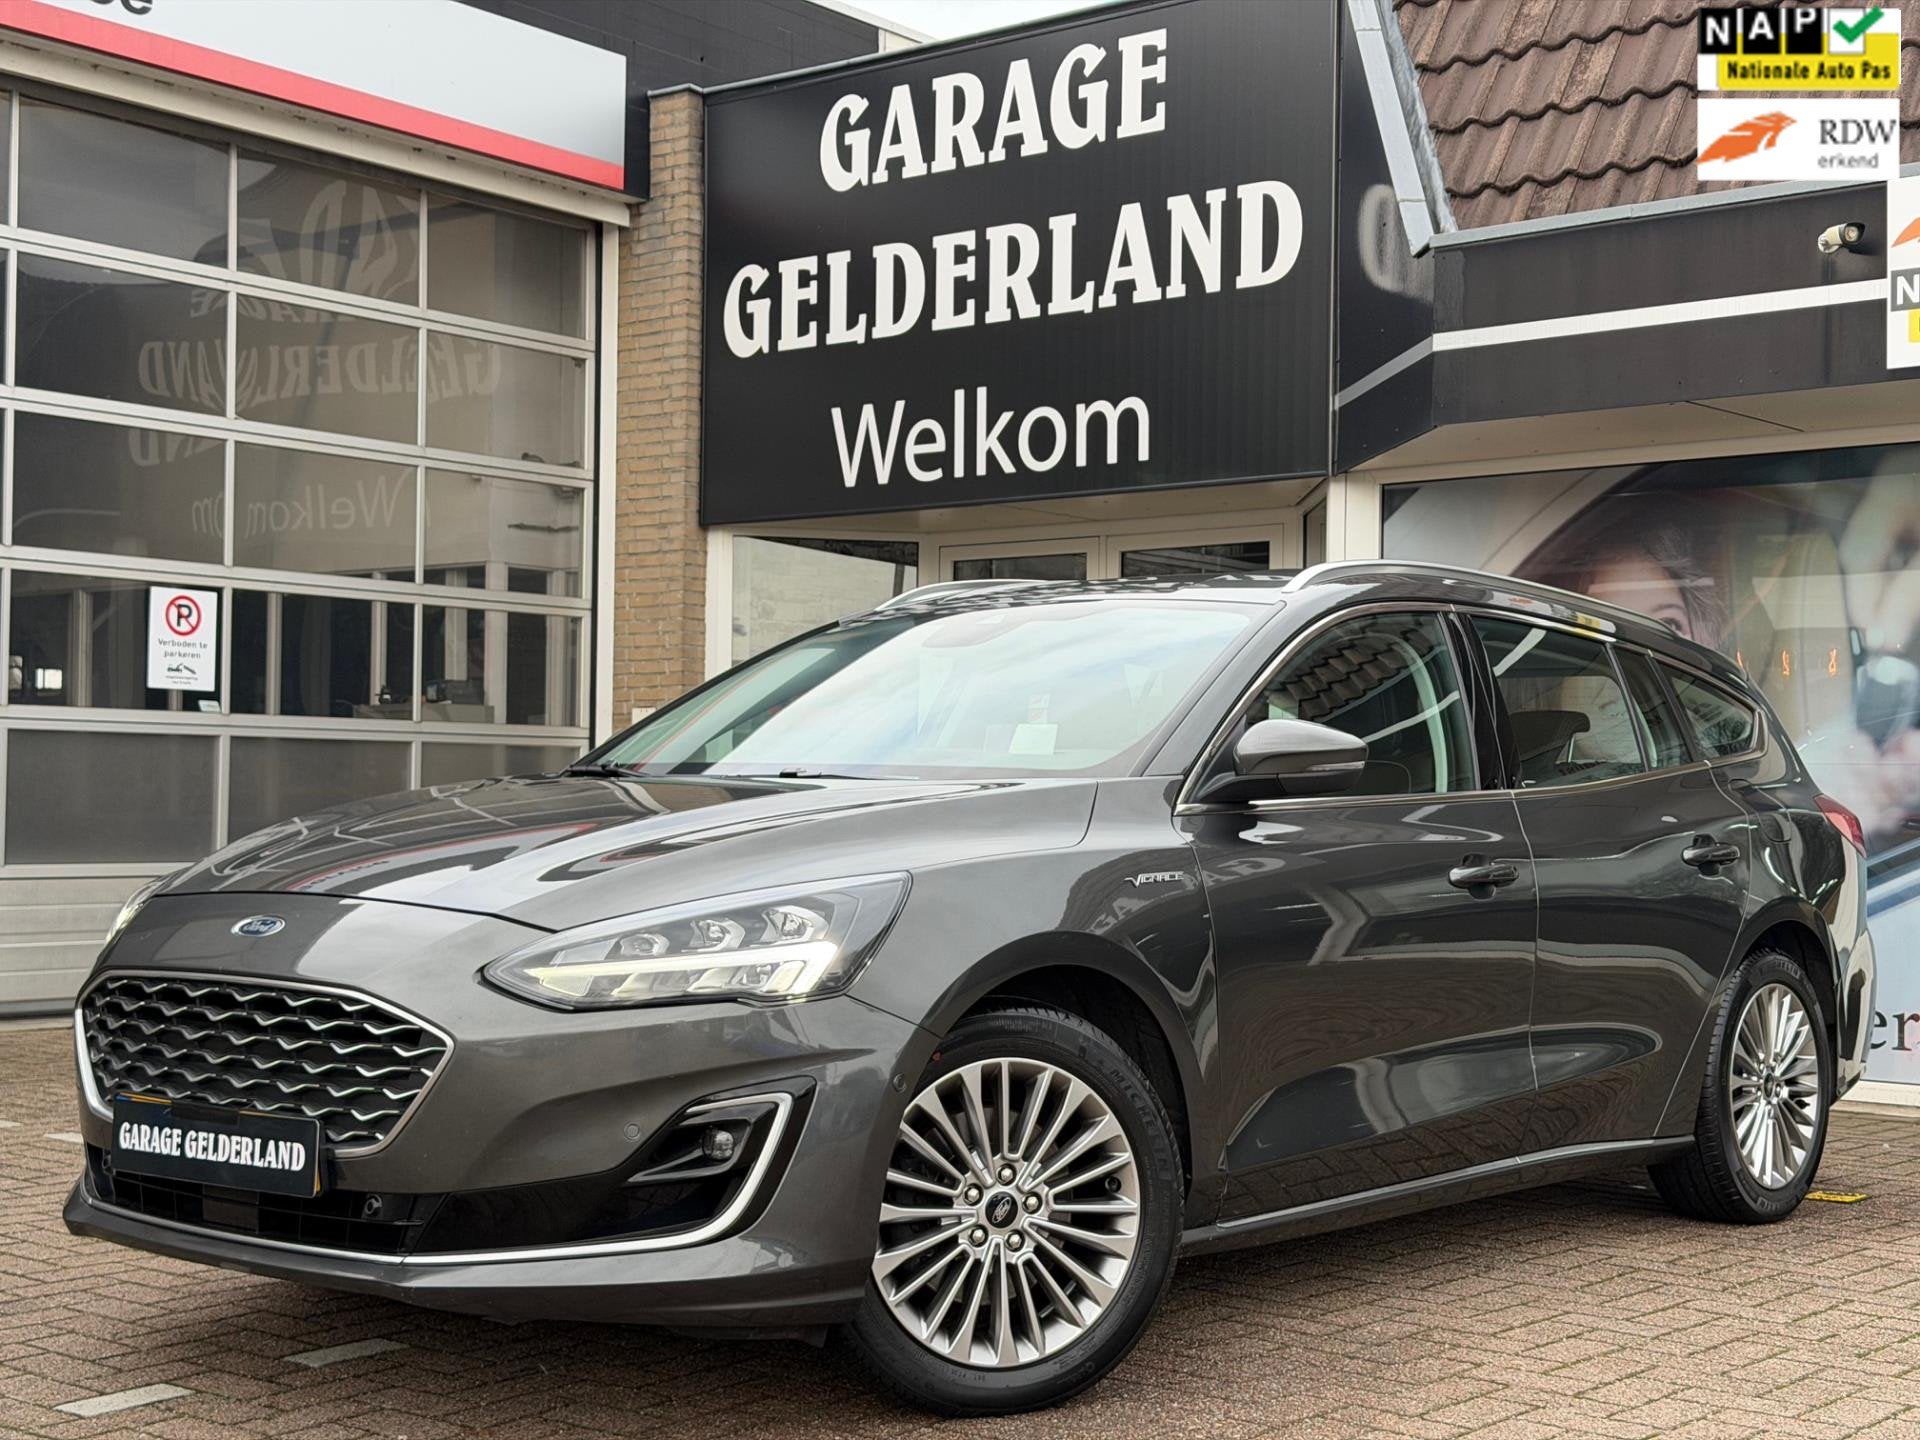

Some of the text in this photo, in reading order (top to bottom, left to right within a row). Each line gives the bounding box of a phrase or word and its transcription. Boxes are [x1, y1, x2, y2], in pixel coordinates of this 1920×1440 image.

[819, 28, 1168, 193] GARAGE
[723, 180, 1304, 359] GELDERLAND
[831, 386, 1150, 488] Welkom
[158, 638, 208, 649] Verboden te
[163, 649, 201, 659] parkeren
[118, 1121, 306, 1172] GARAGE GELDERLAND
